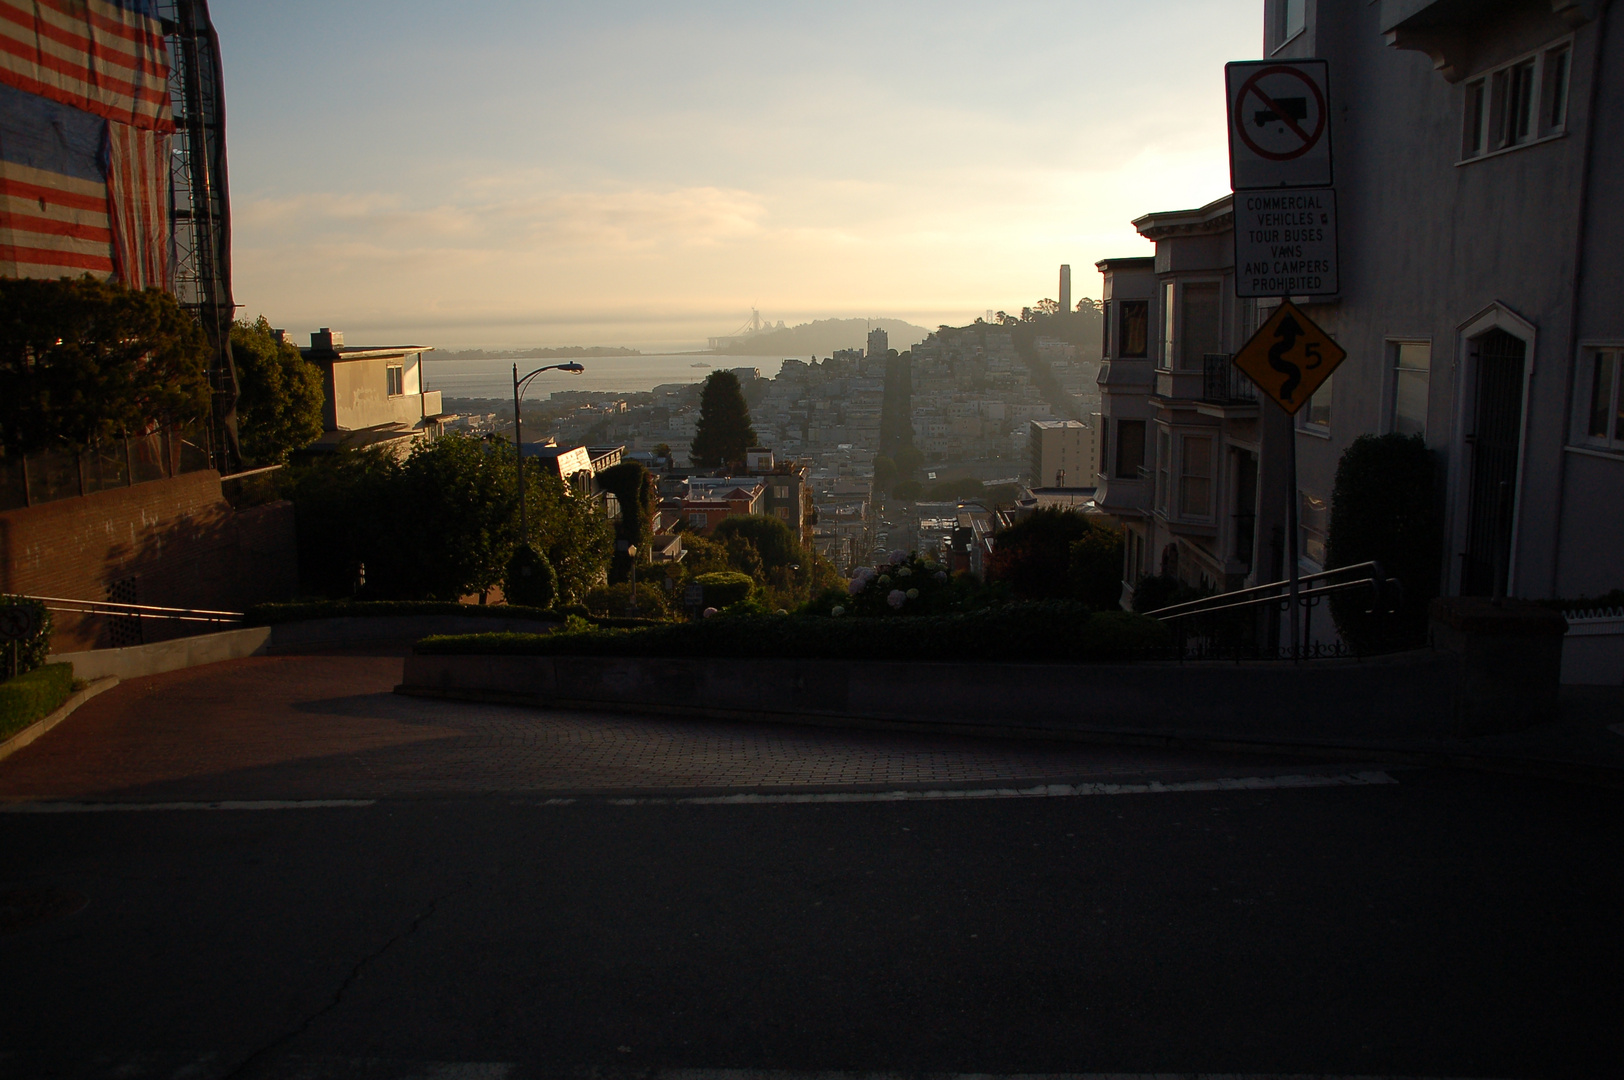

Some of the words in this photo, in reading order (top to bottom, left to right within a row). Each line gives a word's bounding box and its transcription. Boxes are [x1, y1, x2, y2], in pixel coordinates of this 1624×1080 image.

[1247, 196, 1322, 211] COMMERCIAL
[1258, 212, 1314, 226] VEHICLES
[1249, 230, 1279, 243] TOUR
[1284, 229, 1323, 242] BUSES
[1271, 245, 1302, 258] VANS
[1245, 262, 1269, 275] AND
[1273, 260, 1329, 274] CAMPERS
[1252, 276, 1322, 291] PROHIBITED
[1305, 342, 1322, 370] 5
